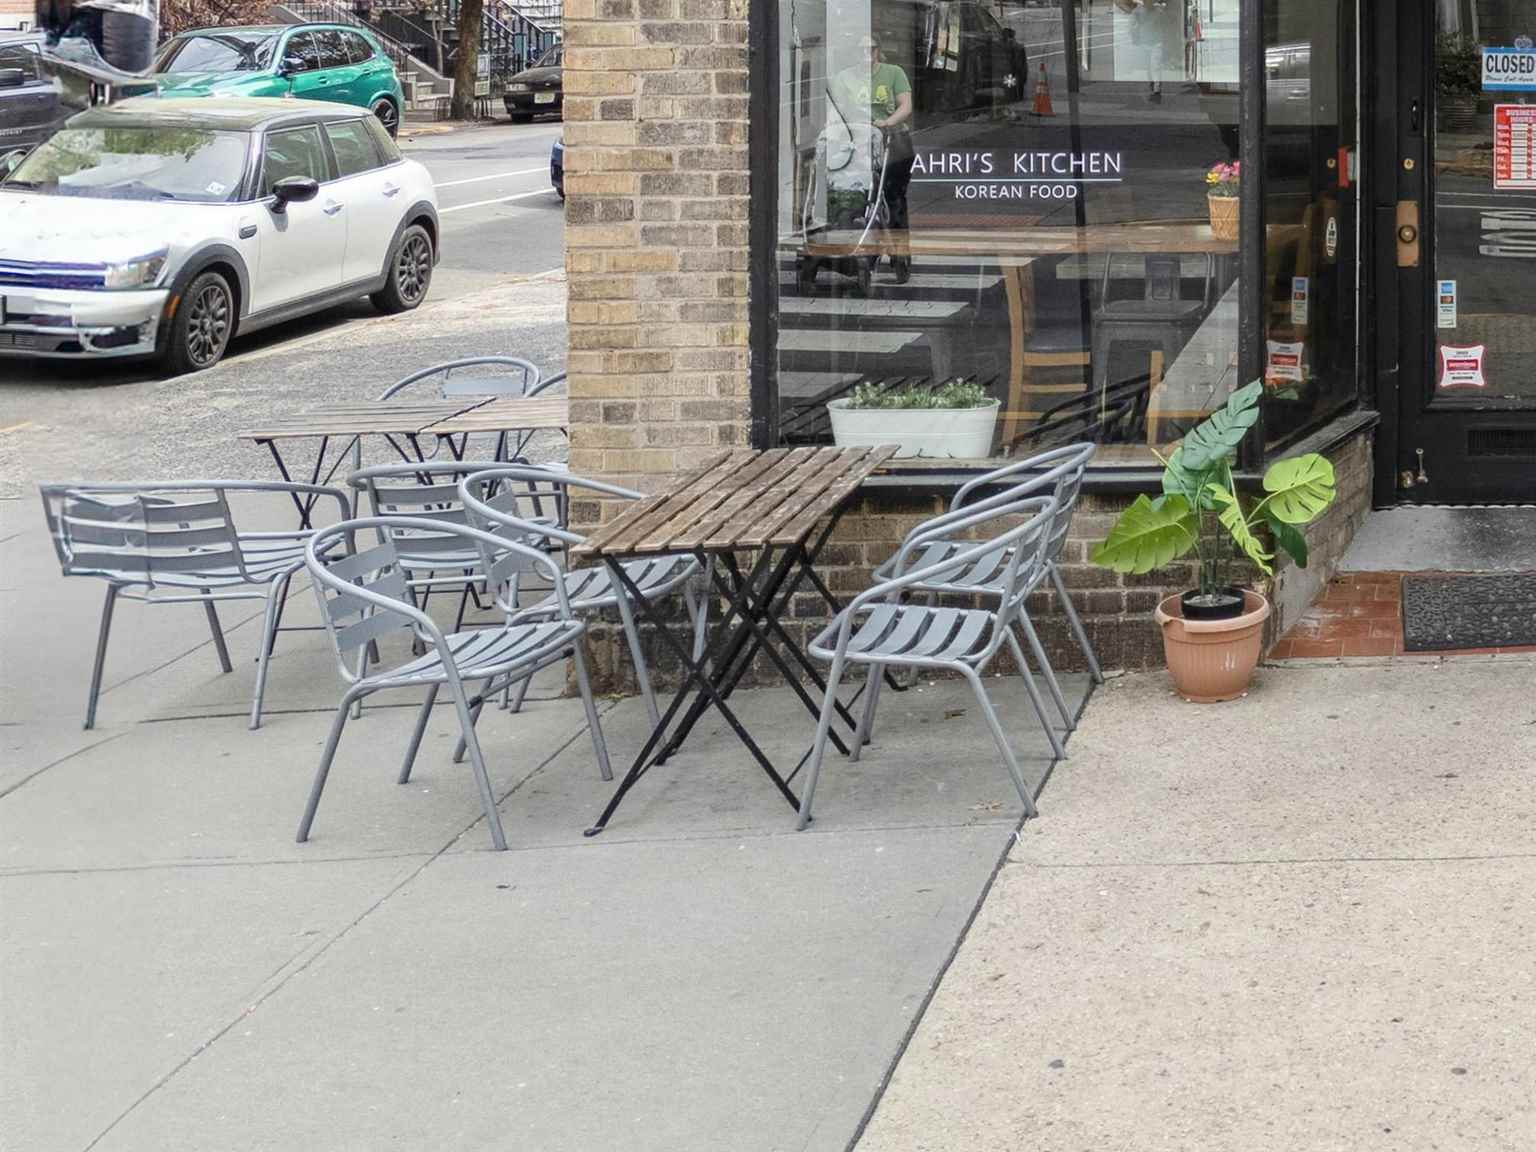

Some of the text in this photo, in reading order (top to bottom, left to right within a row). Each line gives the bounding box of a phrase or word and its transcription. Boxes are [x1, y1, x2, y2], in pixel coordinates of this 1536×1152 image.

[1485, 54, 1535, 74] CLOSED
[910, 152, 1121, 174] AHRI'S KITCHEN
[955, 184, 1078, 199] KOREAN FOOD
